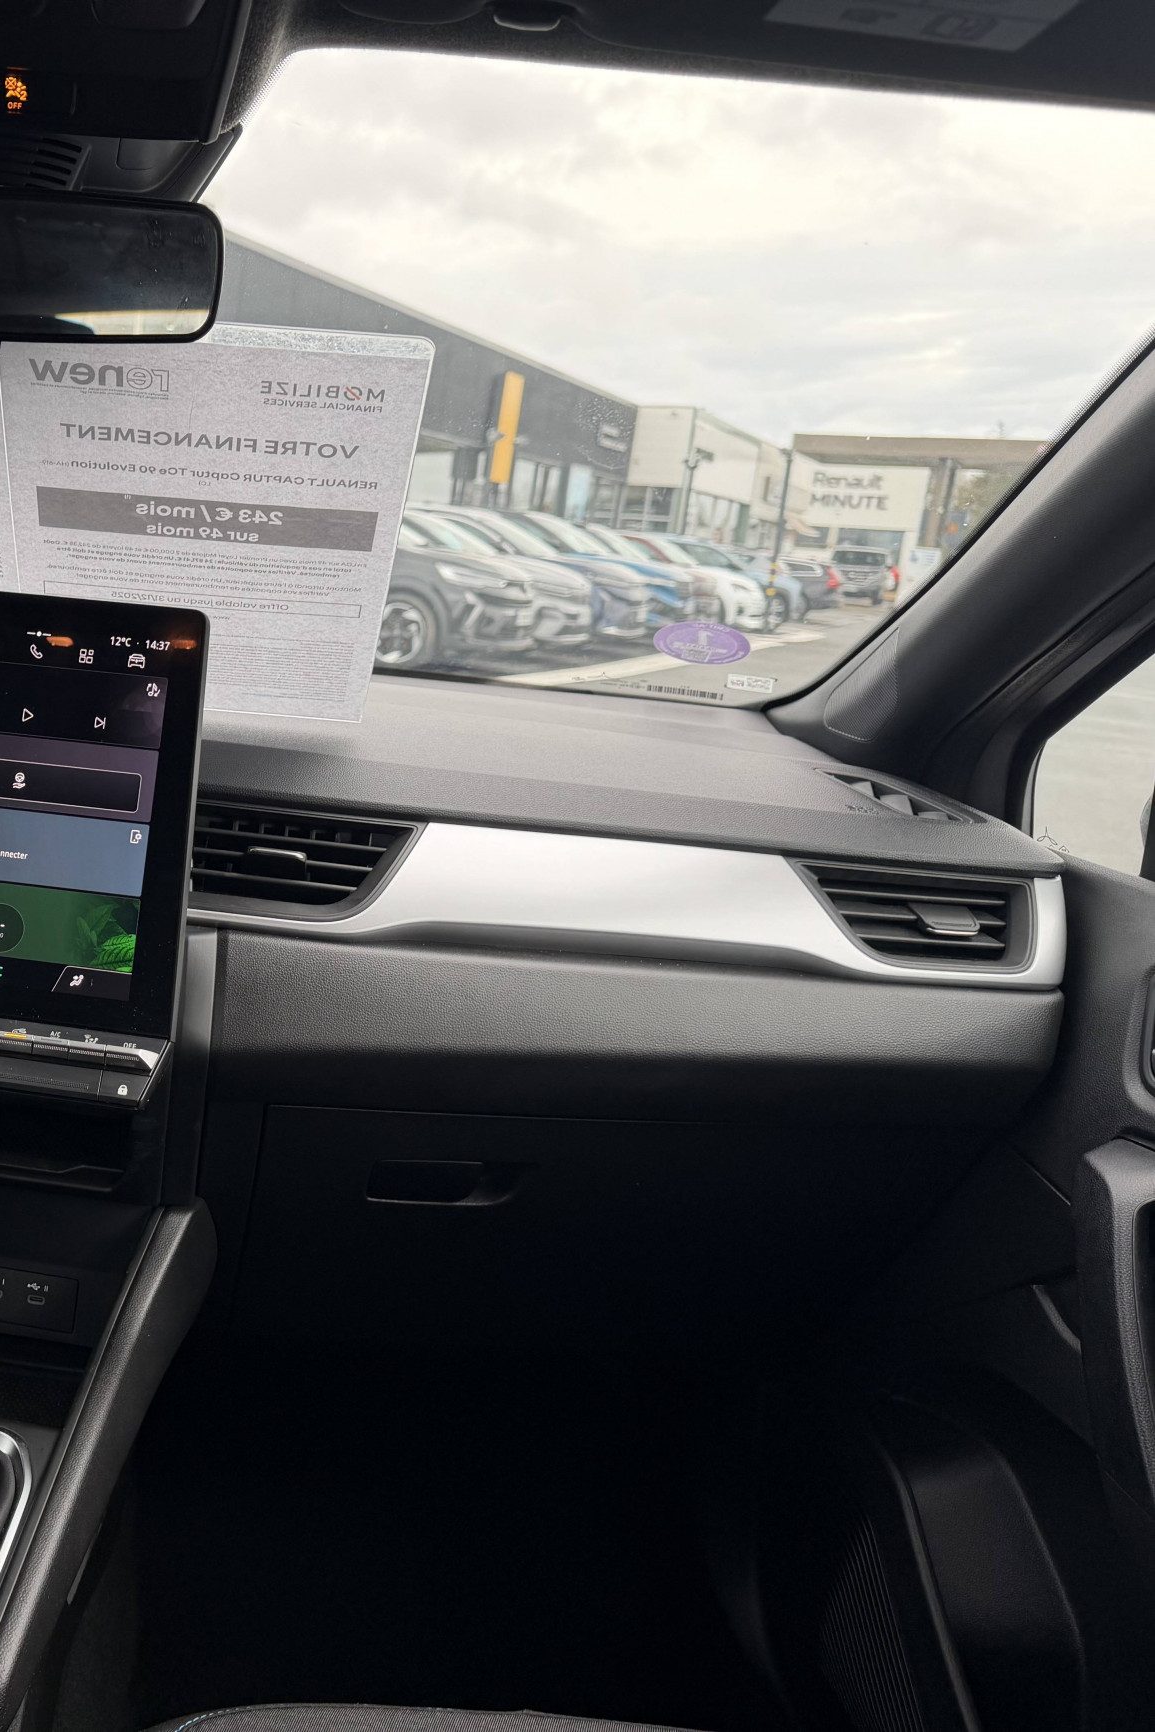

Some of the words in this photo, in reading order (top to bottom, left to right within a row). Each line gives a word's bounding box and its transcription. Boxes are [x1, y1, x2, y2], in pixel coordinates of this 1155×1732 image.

[7, 102, 23, 110] OFF
[812, 472, 883, 491] Renault
[810, 493, 889, 512] MINUTE
[145, 638, 171, 652] 14:37
[50, 1030, 61, 1038] A/C
